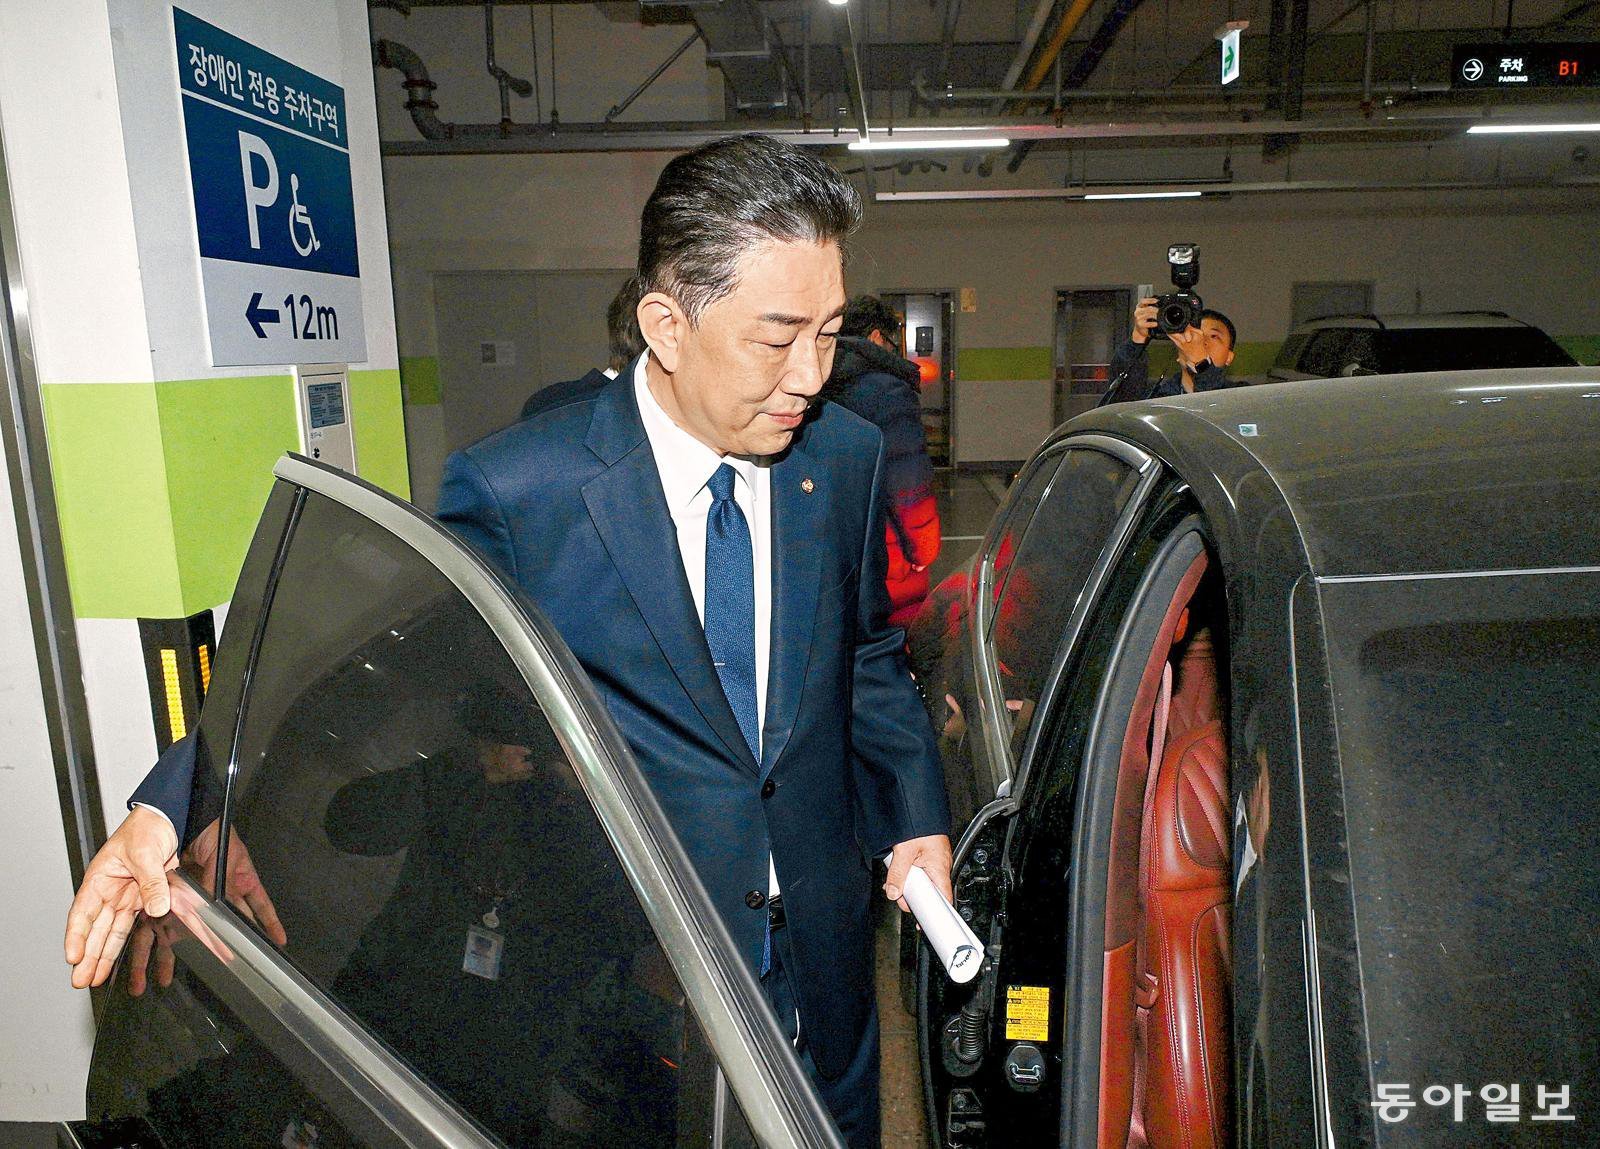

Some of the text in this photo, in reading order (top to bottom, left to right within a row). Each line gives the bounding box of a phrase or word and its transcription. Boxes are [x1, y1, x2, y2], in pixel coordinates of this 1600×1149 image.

[1498, 75, 1528, 83] PARKING
[1500, 58, 1523, 73] 주차
[1559, 61, 1578, 76] B1
[188, 44, 339, 139] 장애인 전용 주차구역
[238, 130, 279, 250] P
[284, 294, 339, 341] 12m
